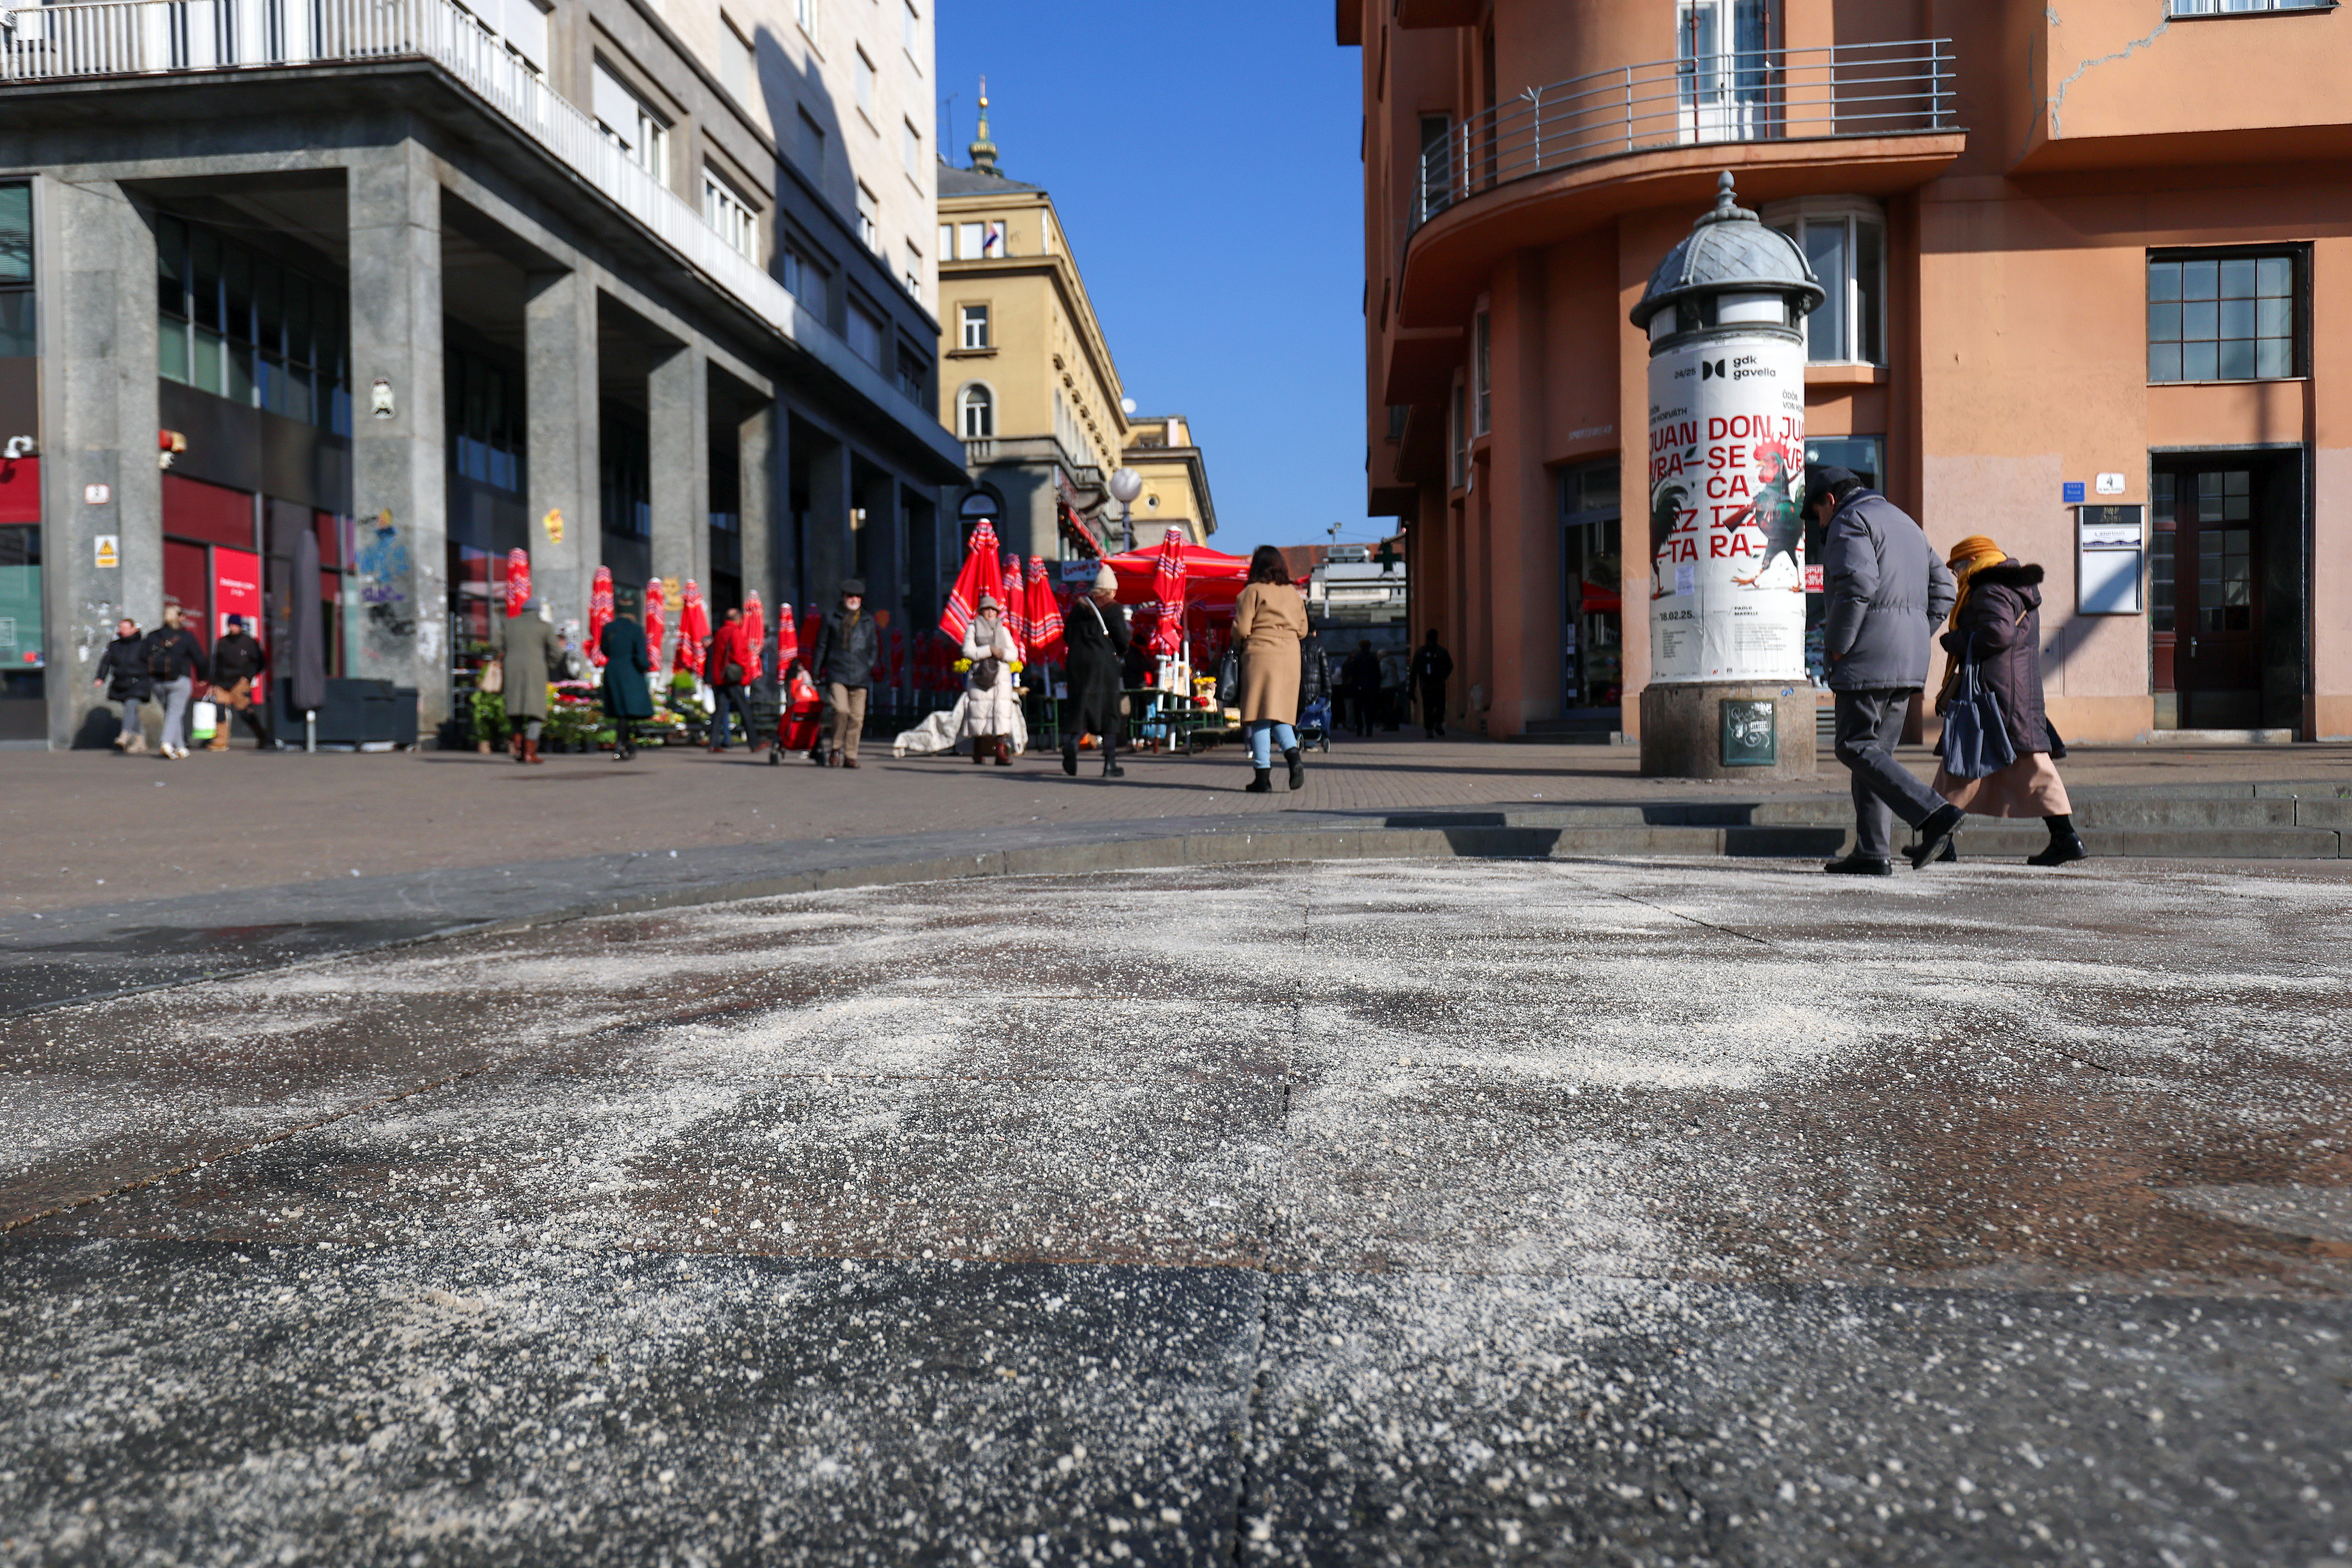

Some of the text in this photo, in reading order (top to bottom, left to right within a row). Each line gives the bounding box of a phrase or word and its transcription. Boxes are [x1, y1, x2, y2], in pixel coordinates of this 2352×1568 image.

[1733, 355, 1756, 368] gdk
[1674, 367, 1696, 379] 24/25
[1733, 367, 1776, 380] gavella
[1782, 401, 1795, 410] VON
[1709, 414, 1771, 441] DON
[1708, 444, 1746, 470] SE
[1706, 470, 1750, 499] ĆA
[2106, 474, 2113, 487] 4
[1659, 609, 1695, 621] 18.02.25.
